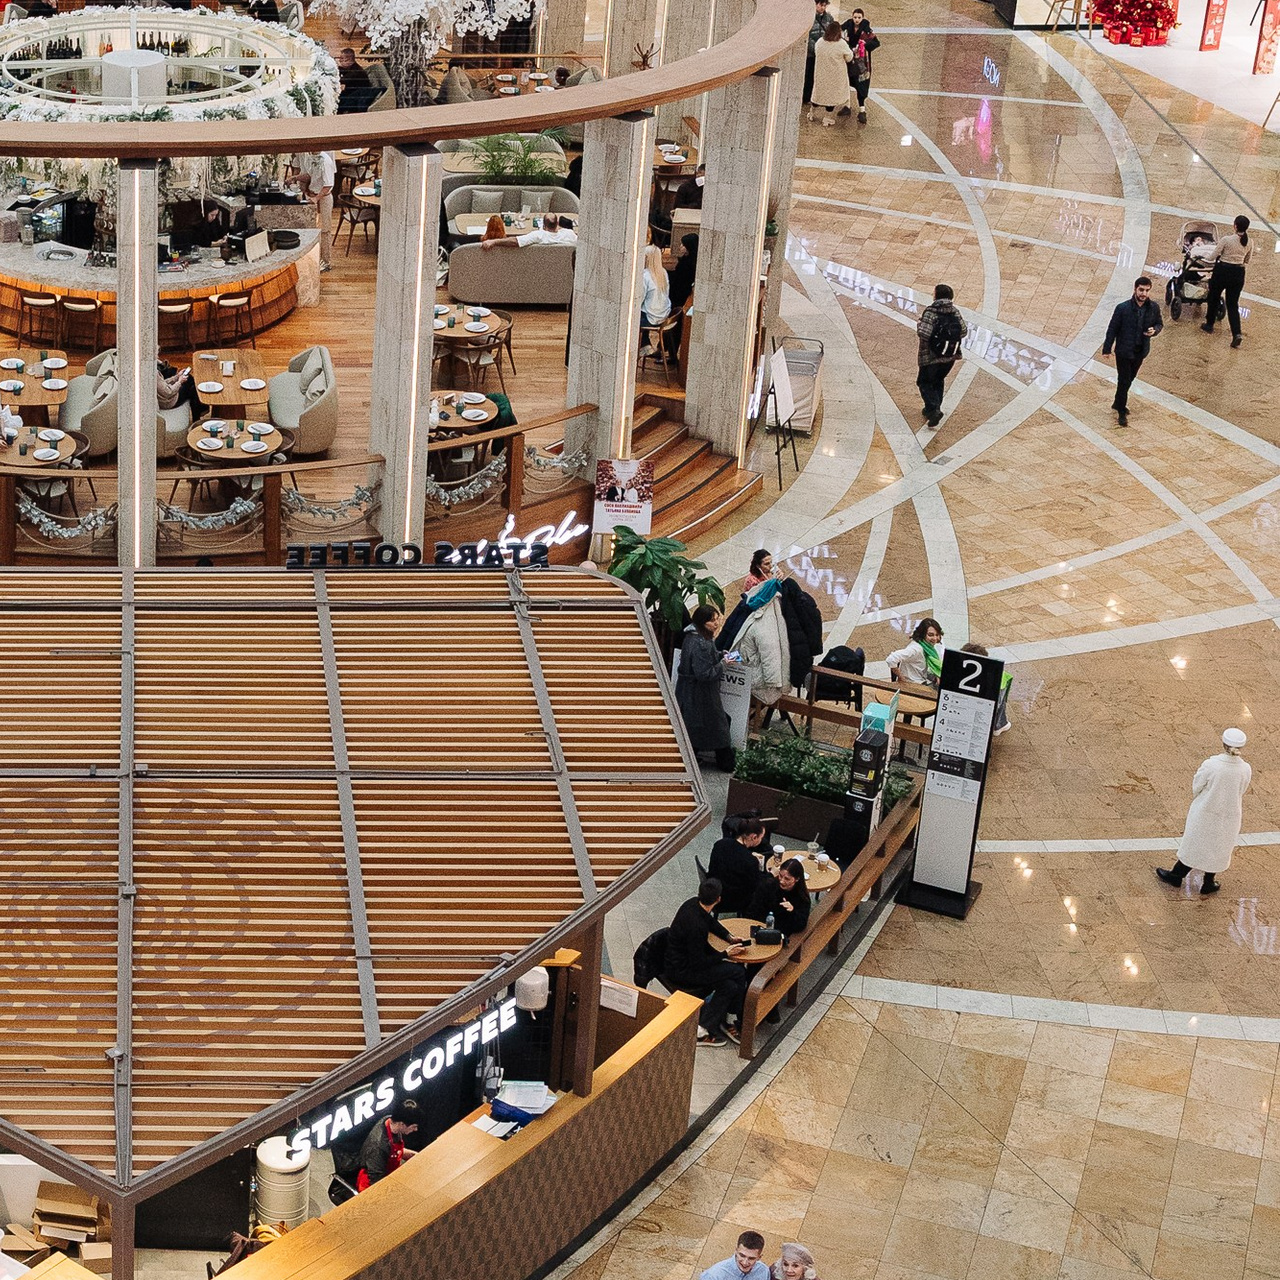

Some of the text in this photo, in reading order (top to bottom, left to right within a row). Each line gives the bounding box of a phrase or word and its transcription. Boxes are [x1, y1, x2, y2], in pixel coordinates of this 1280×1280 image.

[720, 674, 746, 686] EWS
[958, 659, 983, 693] 2
[290, 997, 517, 1163] STARS COFFEE
